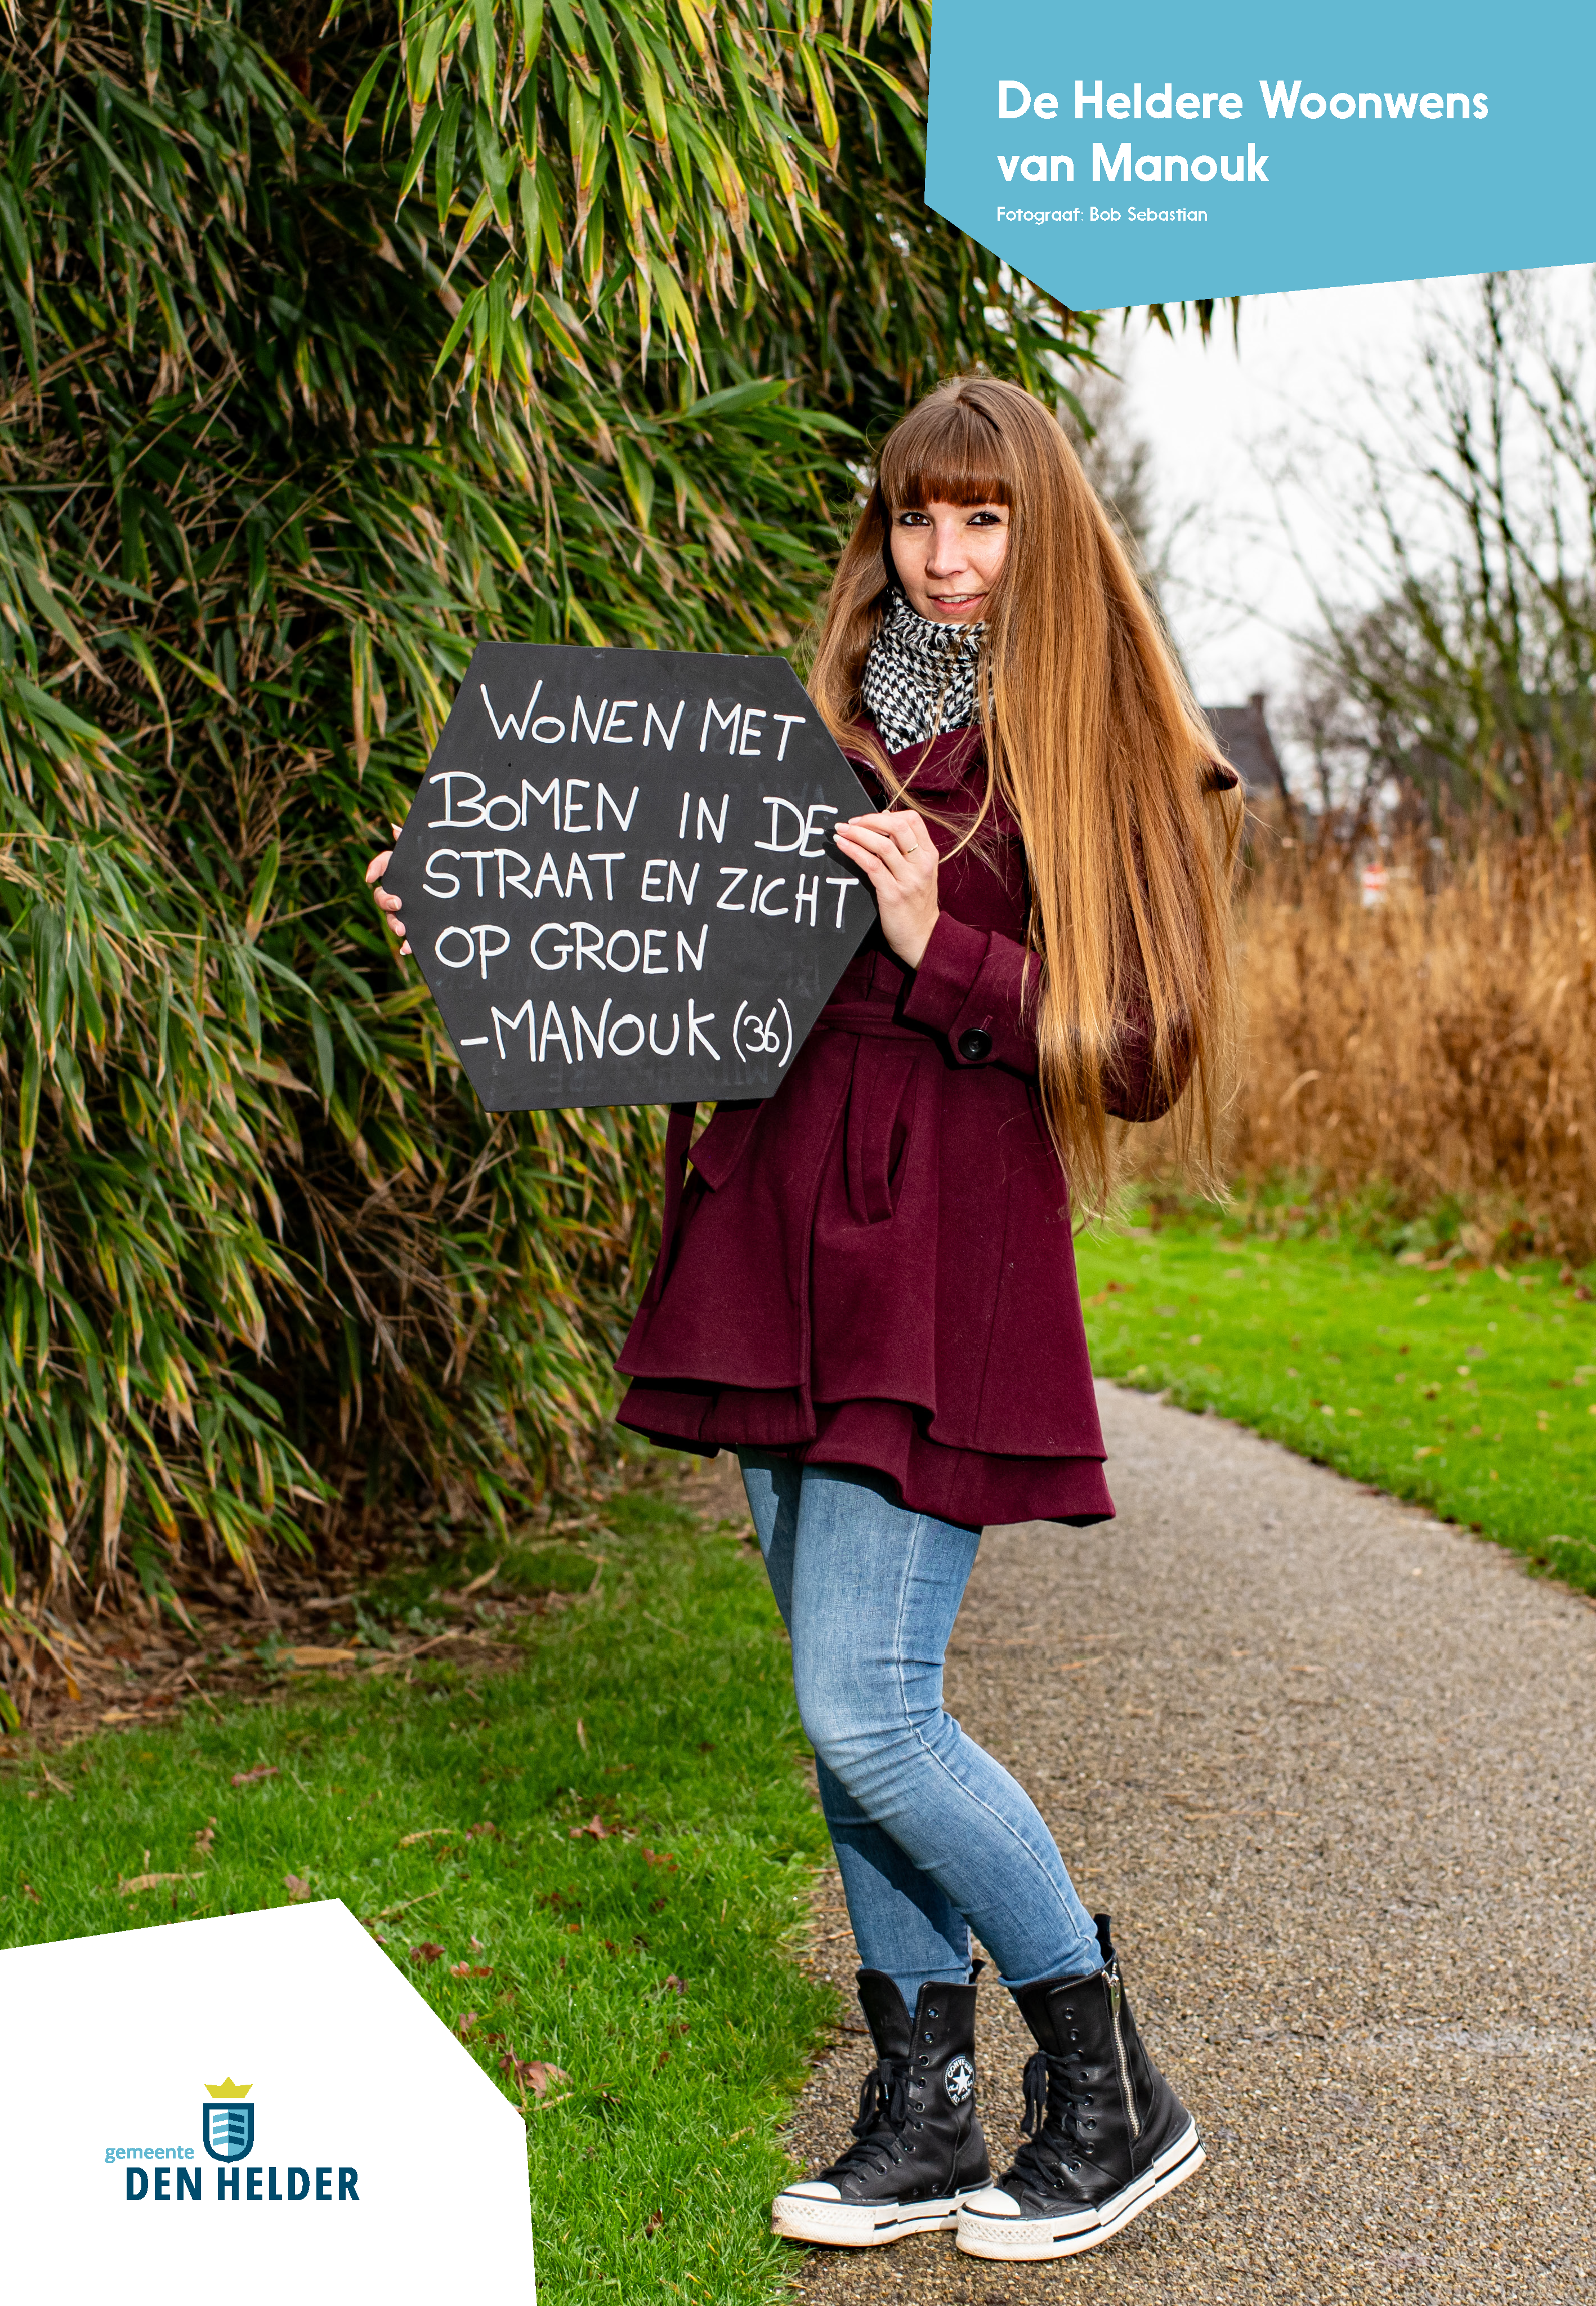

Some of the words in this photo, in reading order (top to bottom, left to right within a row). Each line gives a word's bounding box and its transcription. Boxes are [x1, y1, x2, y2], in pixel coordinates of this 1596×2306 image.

[699, 698, 806, 761] MET
[679, 792, 730, 844] IN
[754, 796, 838, 858] DE
[422, 848, 626, 901] STRAAT
[641, 859, 700, 906] EN
[716, 867, 860, 929] ZICHT
[435, 925, 510, 980] OP
[530, 921, 709, 973] GROEN
[732, 998, 793, 1068] (36)
